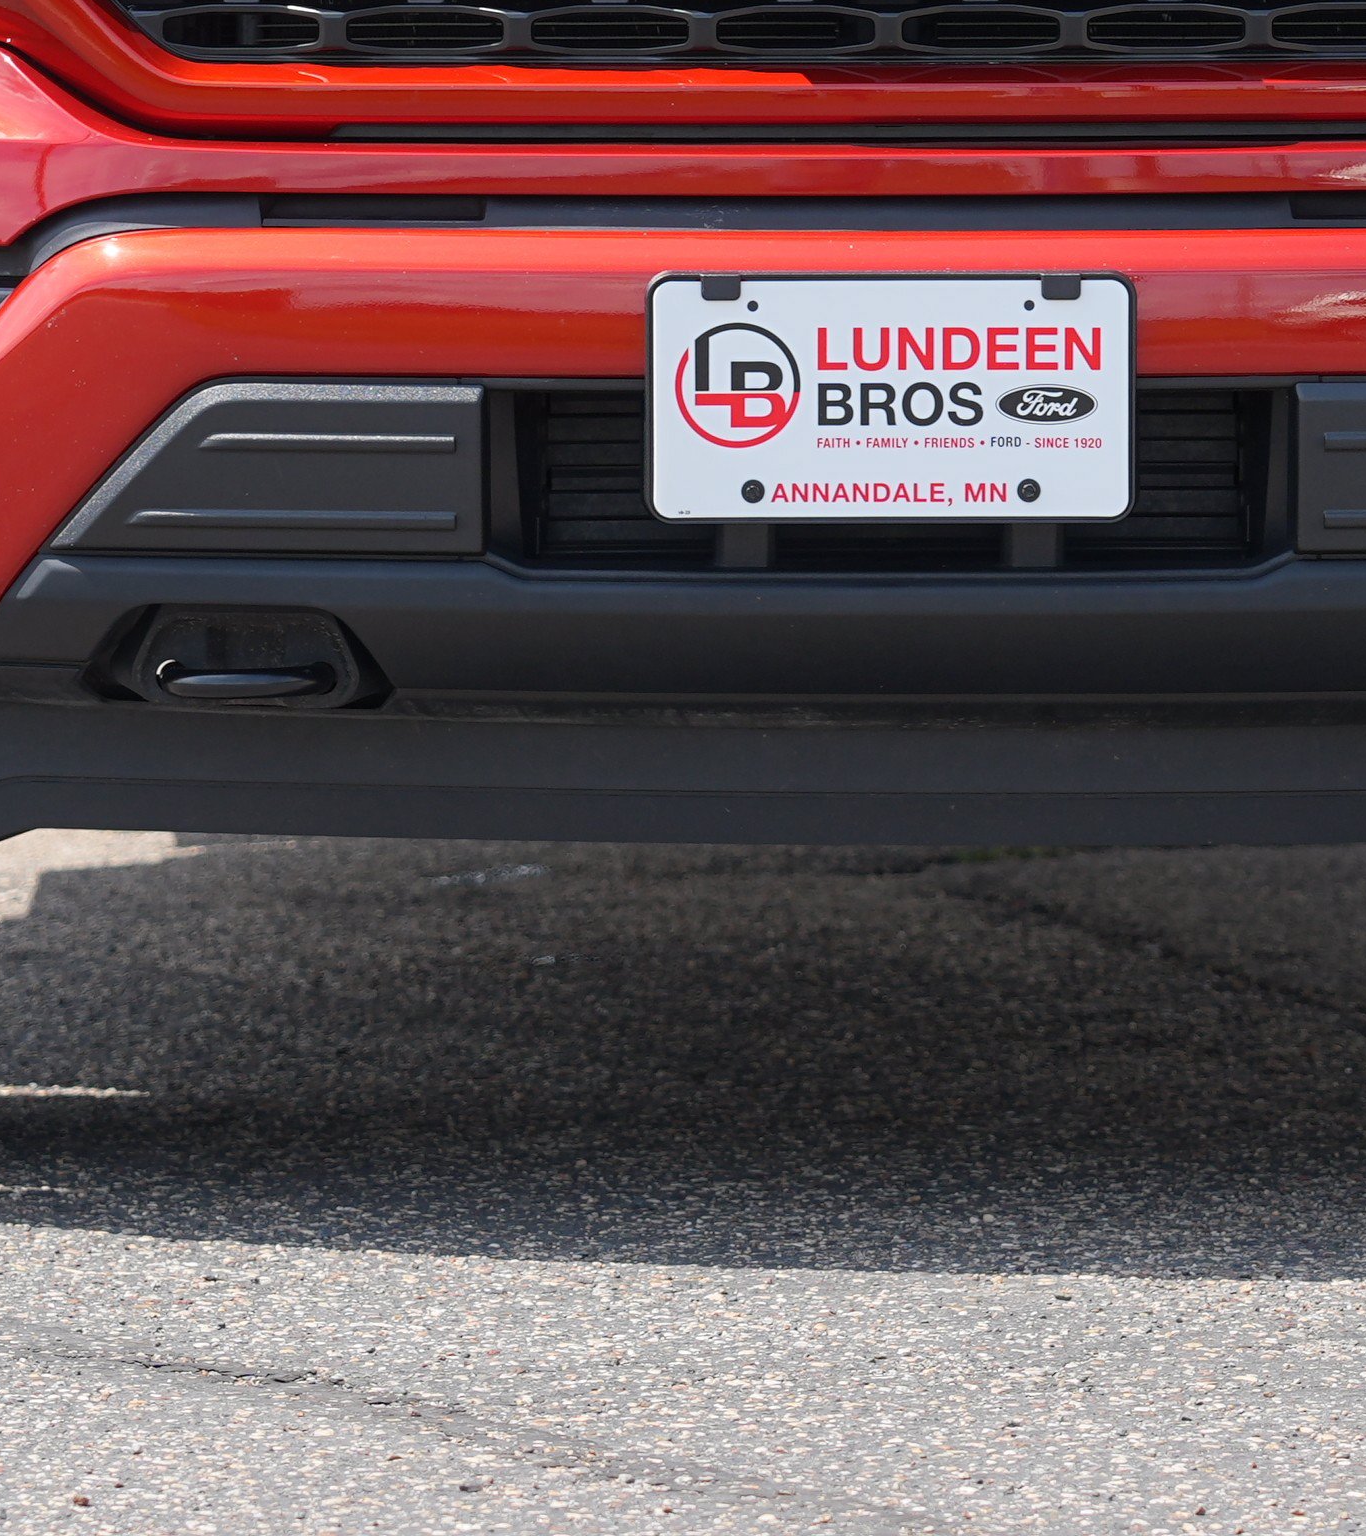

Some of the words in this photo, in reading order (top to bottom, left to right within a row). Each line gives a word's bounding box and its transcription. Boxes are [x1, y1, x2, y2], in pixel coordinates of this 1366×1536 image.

[817, 327, 1102, 371] LUNDEEN
[817, 381, 984, 427] BROS
[1016, 390, 1079, 416] Ford
[817, 437, 851, 449] FAITH
[866, 437, 909, 449] FAMILY
[924, 437, 975, 449] FRIENDS
[990, 436, 1022, 448] FORD
[1034, 437, 1070, 449] SINCE
[1074, 437, 1102, 449] 1920
[771, 482, 953, 507] ANNANDALE,
[964, 482, 1007, 503] MN
